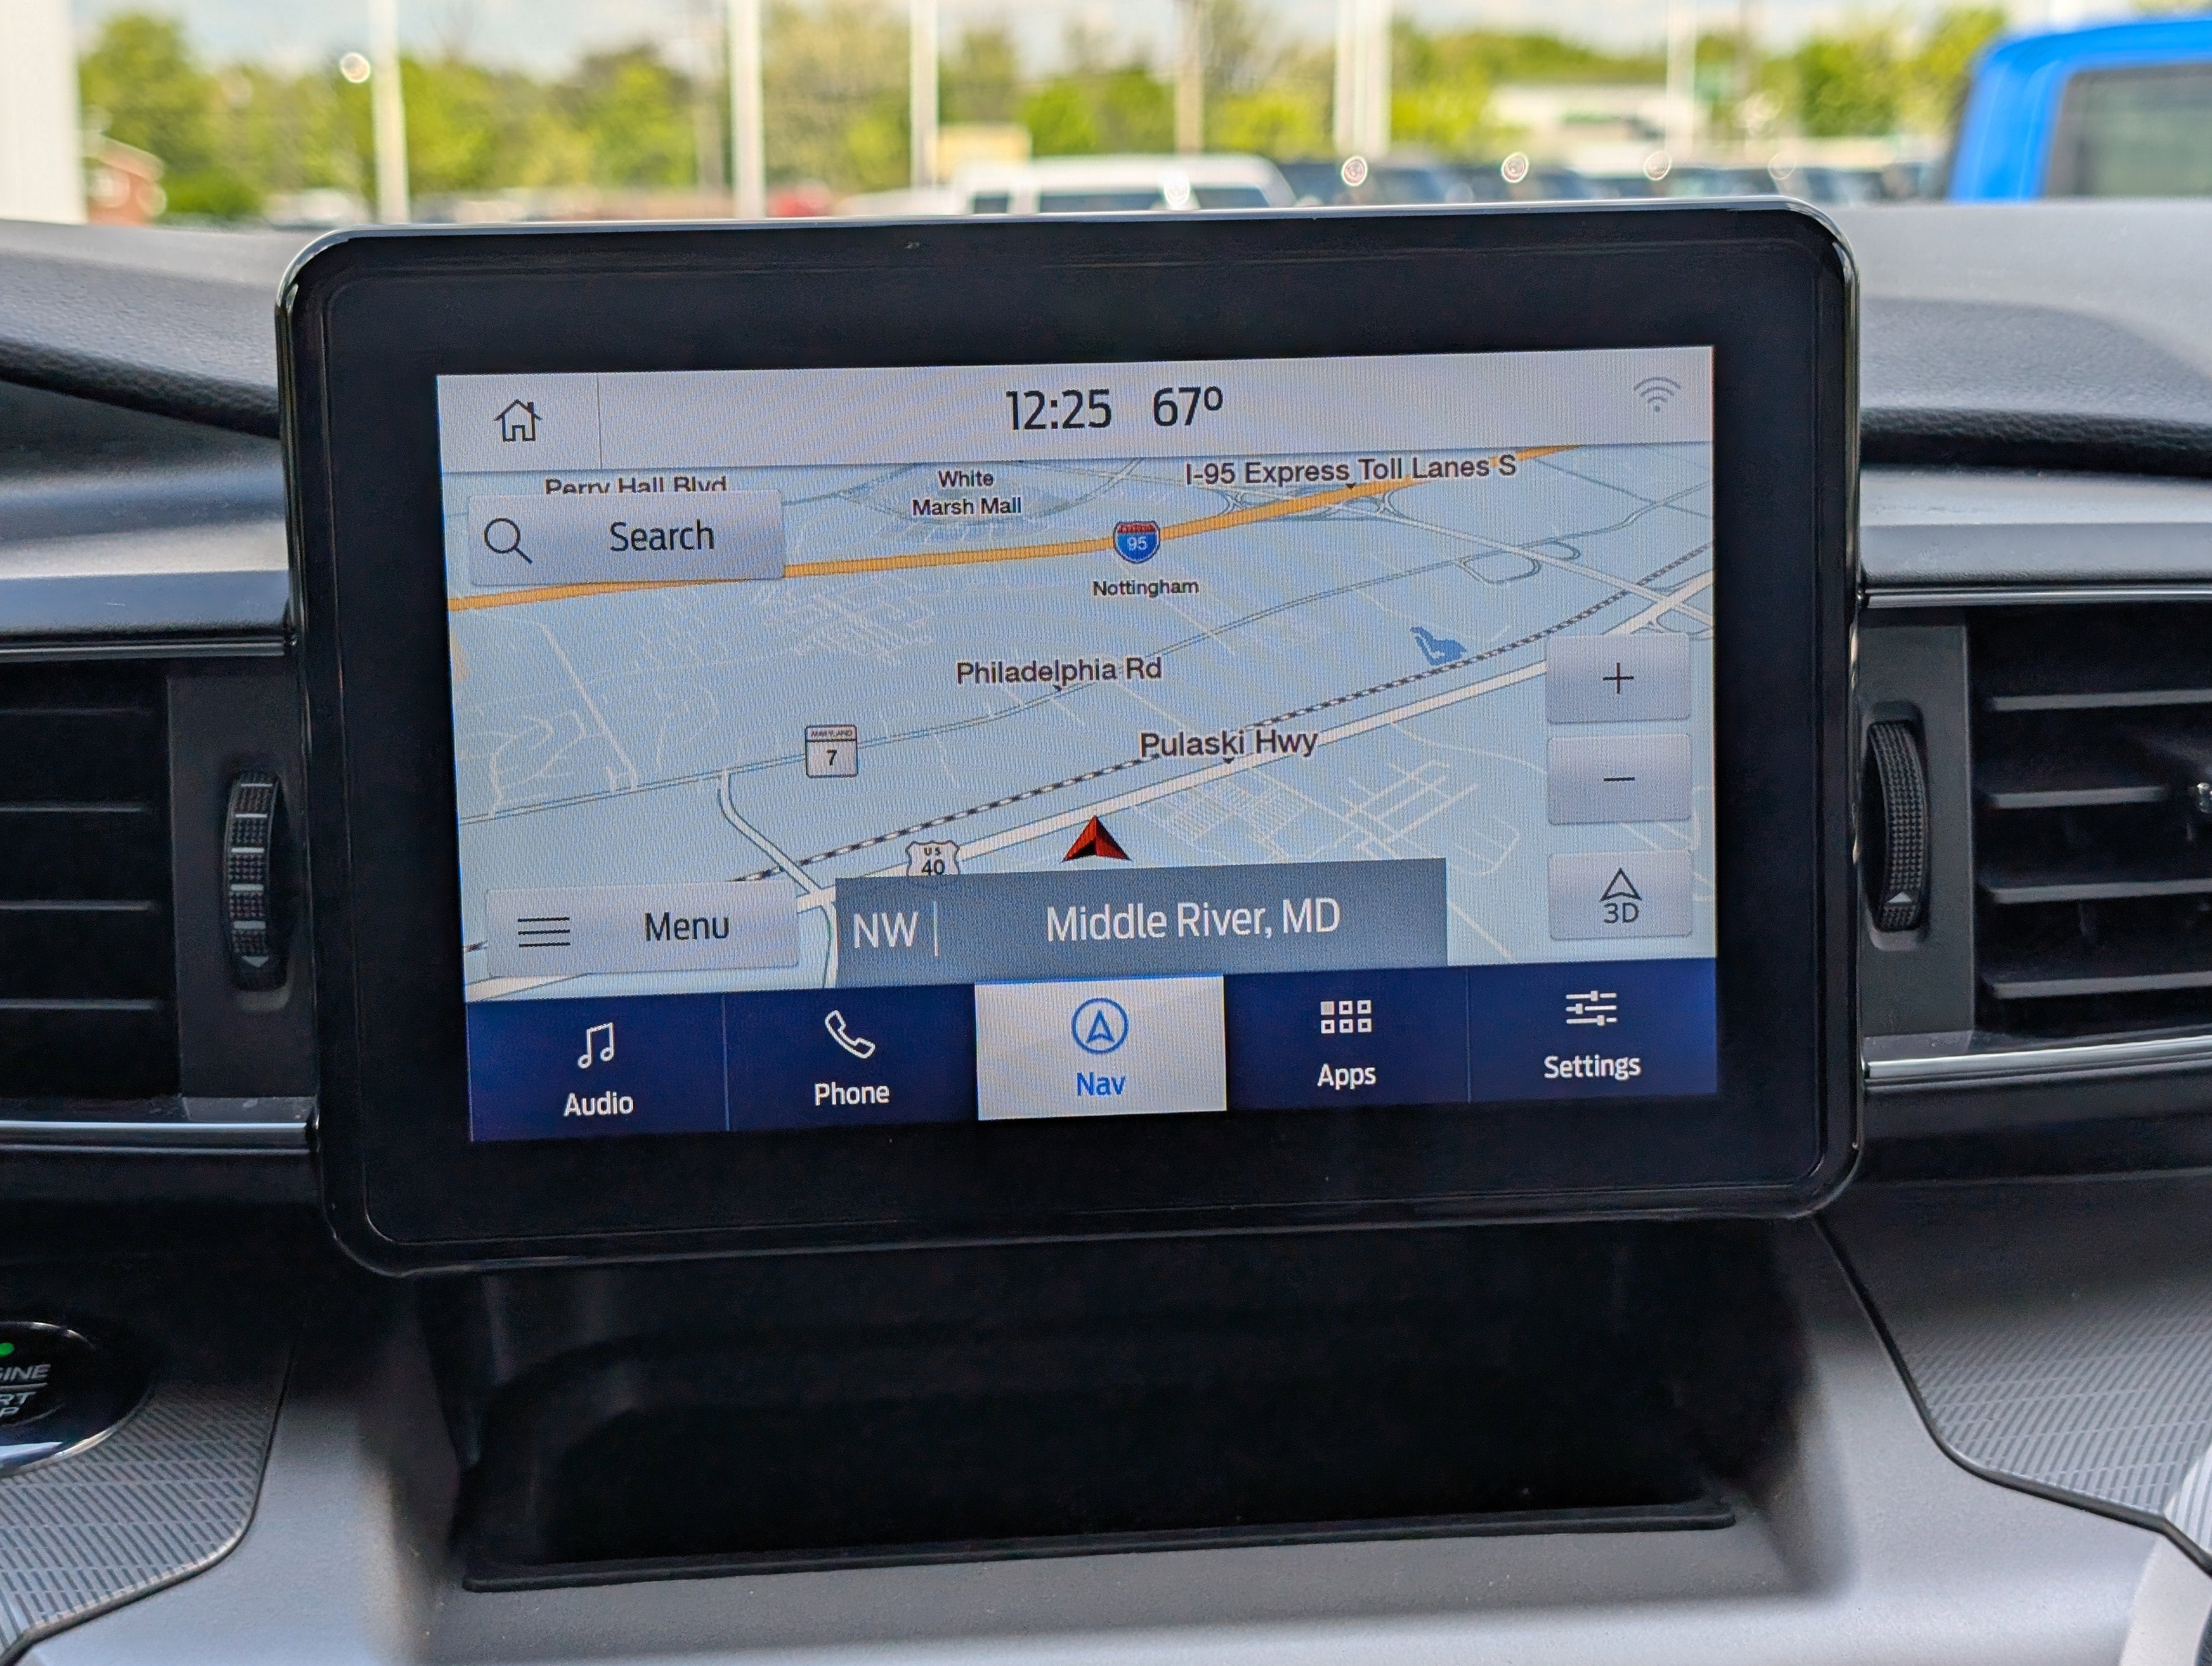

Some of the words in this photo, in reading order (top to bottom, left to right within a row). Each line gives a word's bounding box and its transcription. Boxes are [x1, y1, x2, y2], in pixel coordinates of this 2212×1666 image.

[1006, 389, 1113, 431] 12:25
[938, 470, 994, 488] White
[1186, 462, 1236, 485] I-95
[1245, 460, 1350, 488] Express
[1358, 457, 1403, 481] Toll
[1412, 454, 1489, 479] Lanes
[1498, 454, 1516, 477] S
[618, 477, 664, 493] Hall
[912, 498, 974, 516] Marsh
[981, 496, 1022, 514] Mall
[610, 518, 715, 552] Search
[1127, 535, 1147, 550] 95
[1093, 578, 1199, 598] Nottingham
[956, 658, 1116, 687] Philadelphia
[1126, 657, 1162, 680] Rd
[1141, 729, 1245, 758] Pulaski
[1256, 728, 1318, 757] Hwy
[826, 748, 838, 766] 7
[922, 858, 945, 875] 40
[1046, 905, 1167, 943] Middle
[1178, 901, 1272, 939] River,
[1282, 897, 1340, 934] MD
[1603, 902, 1640, 924] 3D
[645, 911, 730, 941] Menu
[853, 912, 918, 949] NW
[1317, 1063, 1377, 1090] Apps
[1544, 1054, 1641, 1081] Settings
[814, 1082, 890, 1107] Phone
[1076, 1073, 1126, 1097] Nav
[564, 1092, 634, 1117] Audio
